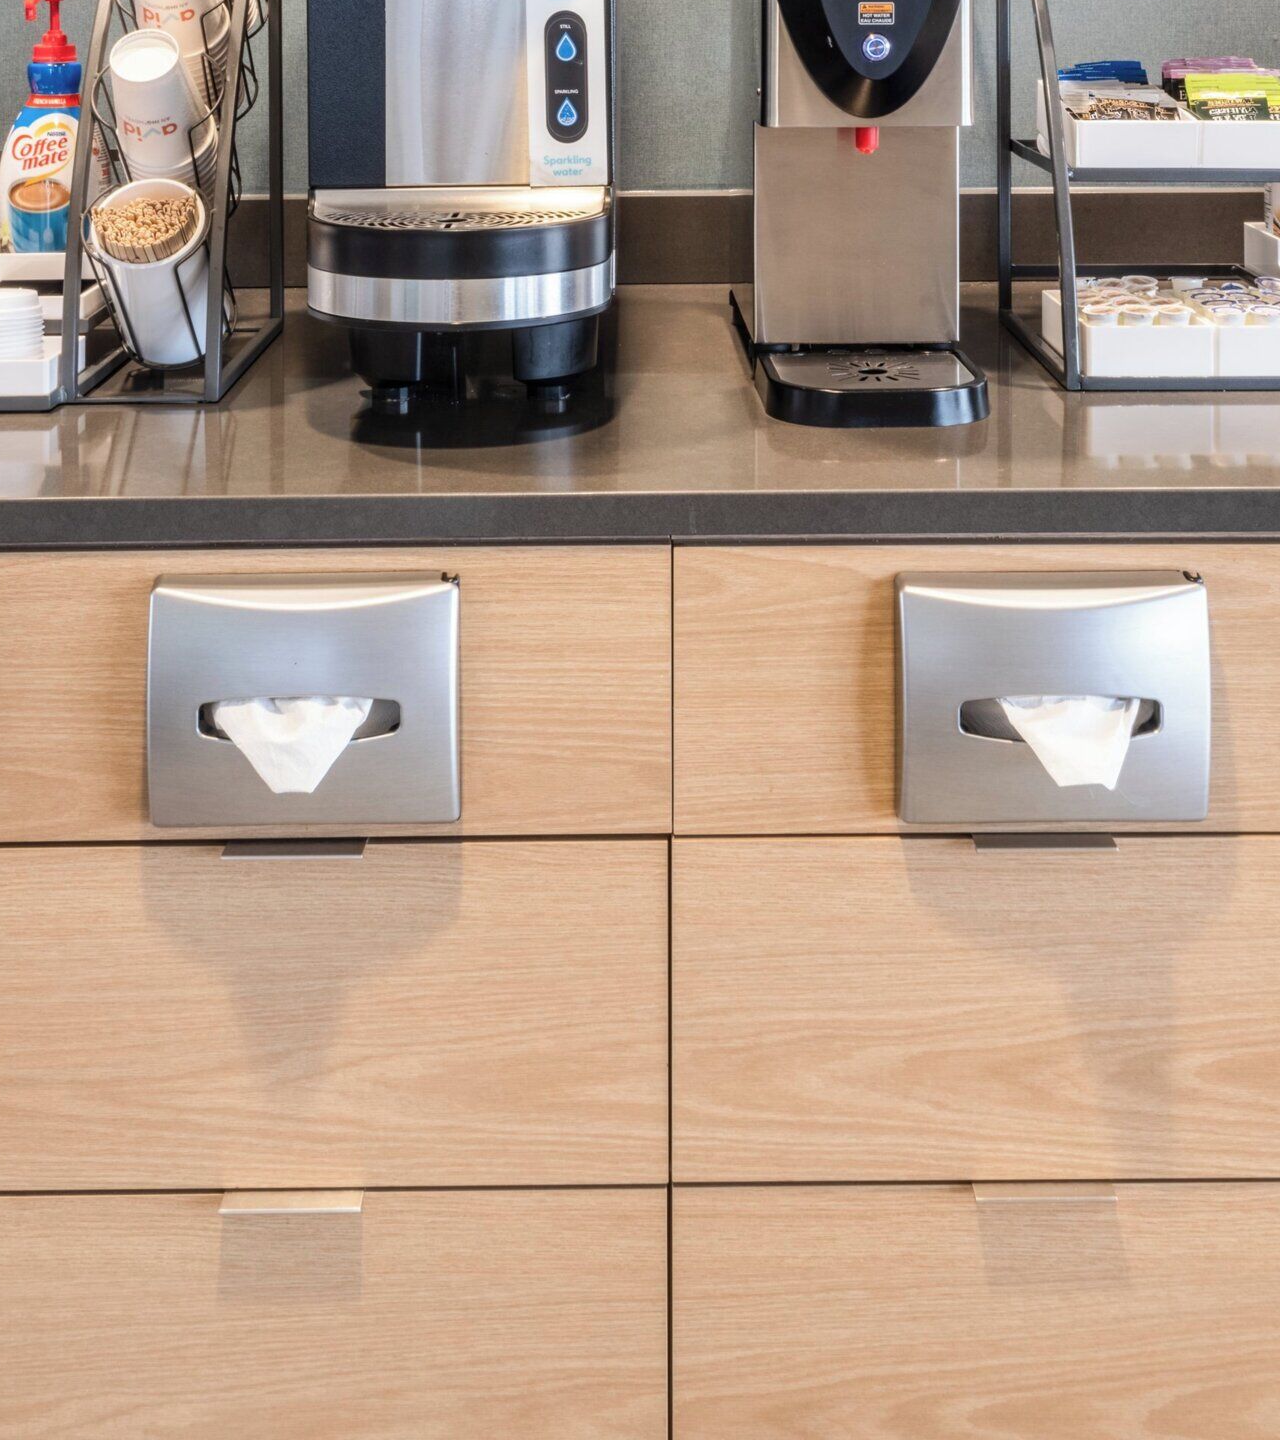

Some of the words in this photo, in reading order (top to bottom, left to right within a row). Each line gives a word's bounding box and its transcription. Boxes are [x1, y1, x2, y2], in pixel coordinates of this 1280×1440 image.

[143, 7, 195, 28] avid
[123, 121, 177, 142] avid
[12, 134, 68, 160] Coffee
[22, 149, 68, 171] mate
[543, 155, 592, 166] Sparkling
[553, 168, 583, 176] water
